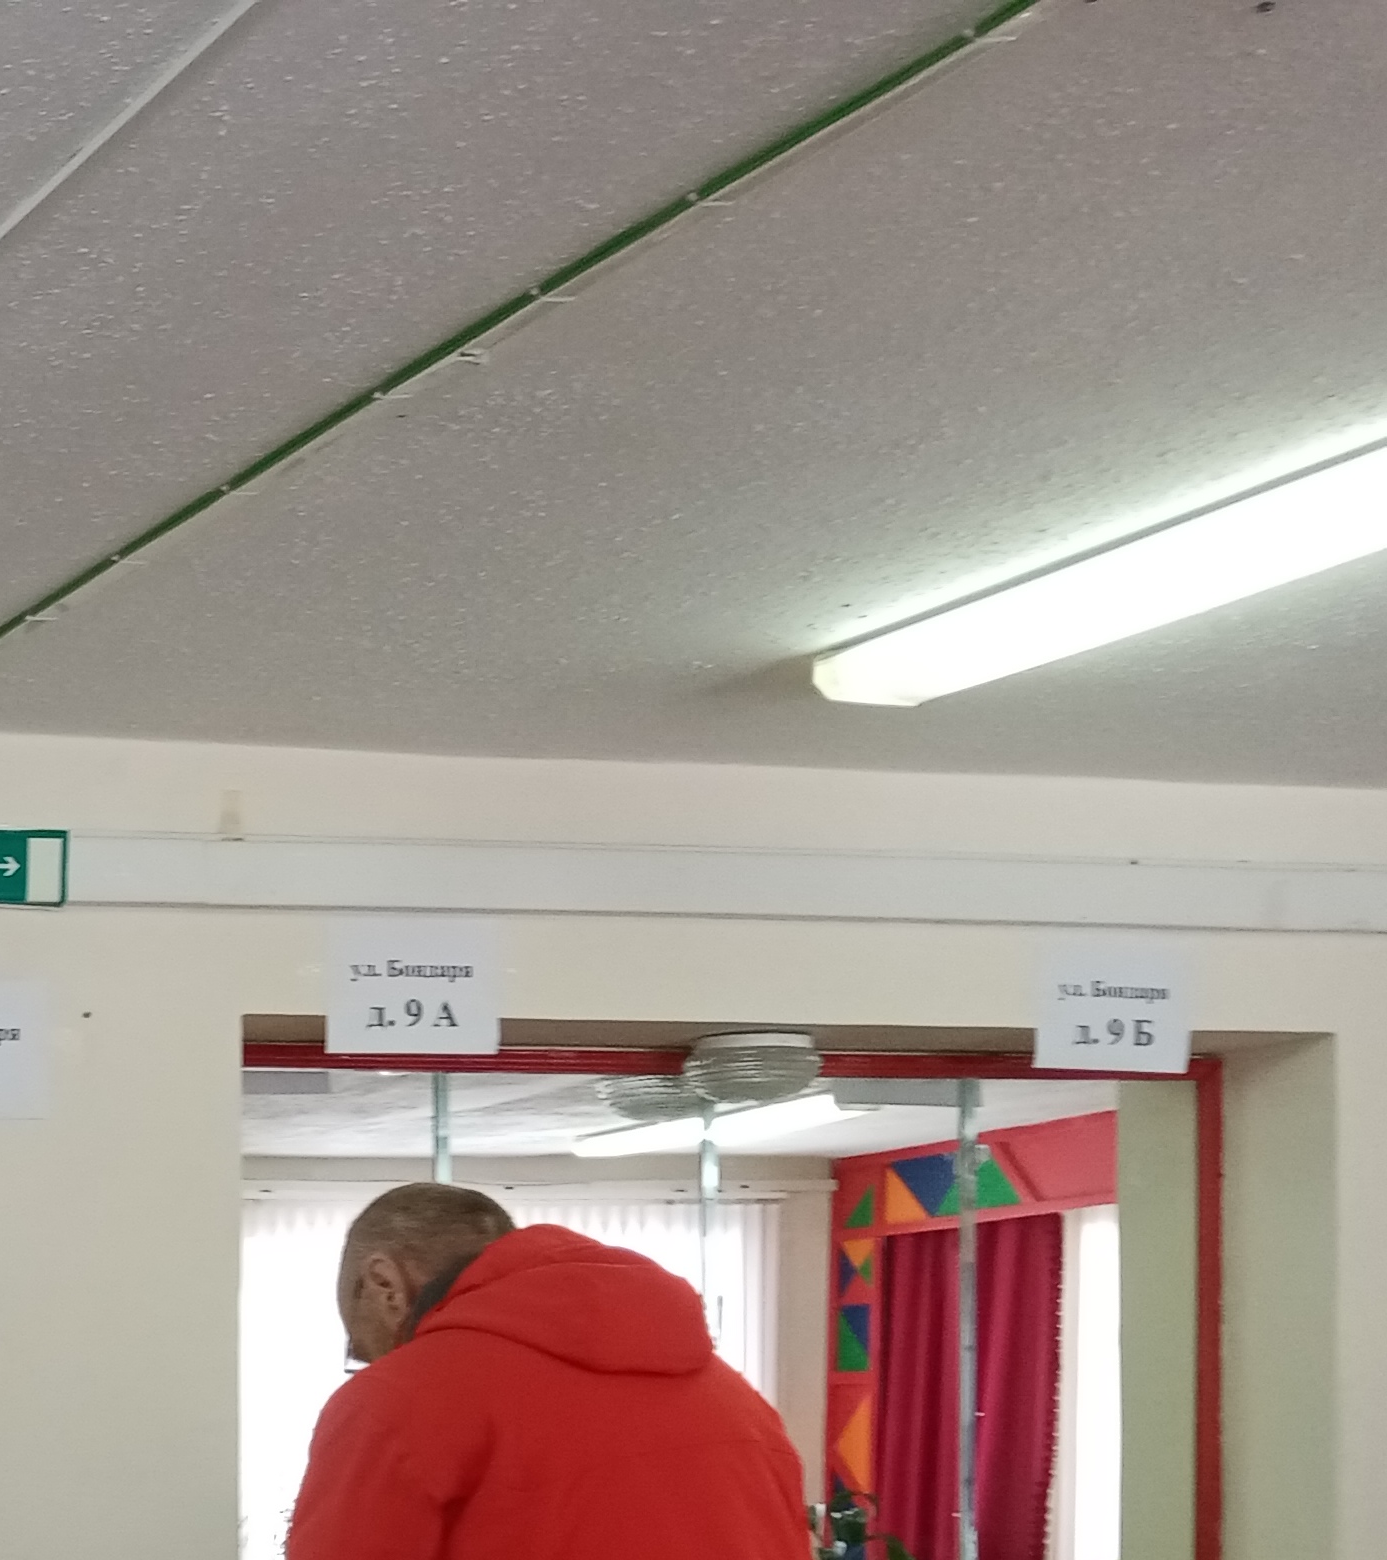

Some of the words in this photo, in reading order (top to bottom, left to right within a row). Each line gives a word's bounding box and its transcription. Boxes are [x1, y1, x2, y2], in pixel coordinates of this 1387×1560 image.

[349, 964, 383, 982] ул.
[386, 959, 475, 983] Бондаря
[1056, 983, 1088, 1001] ул.
[1090, 980, 1171, 1004] Бондаря
[366, 1006, 397, 1029] д.
[1072, 1024, 1100, 1045] д.
